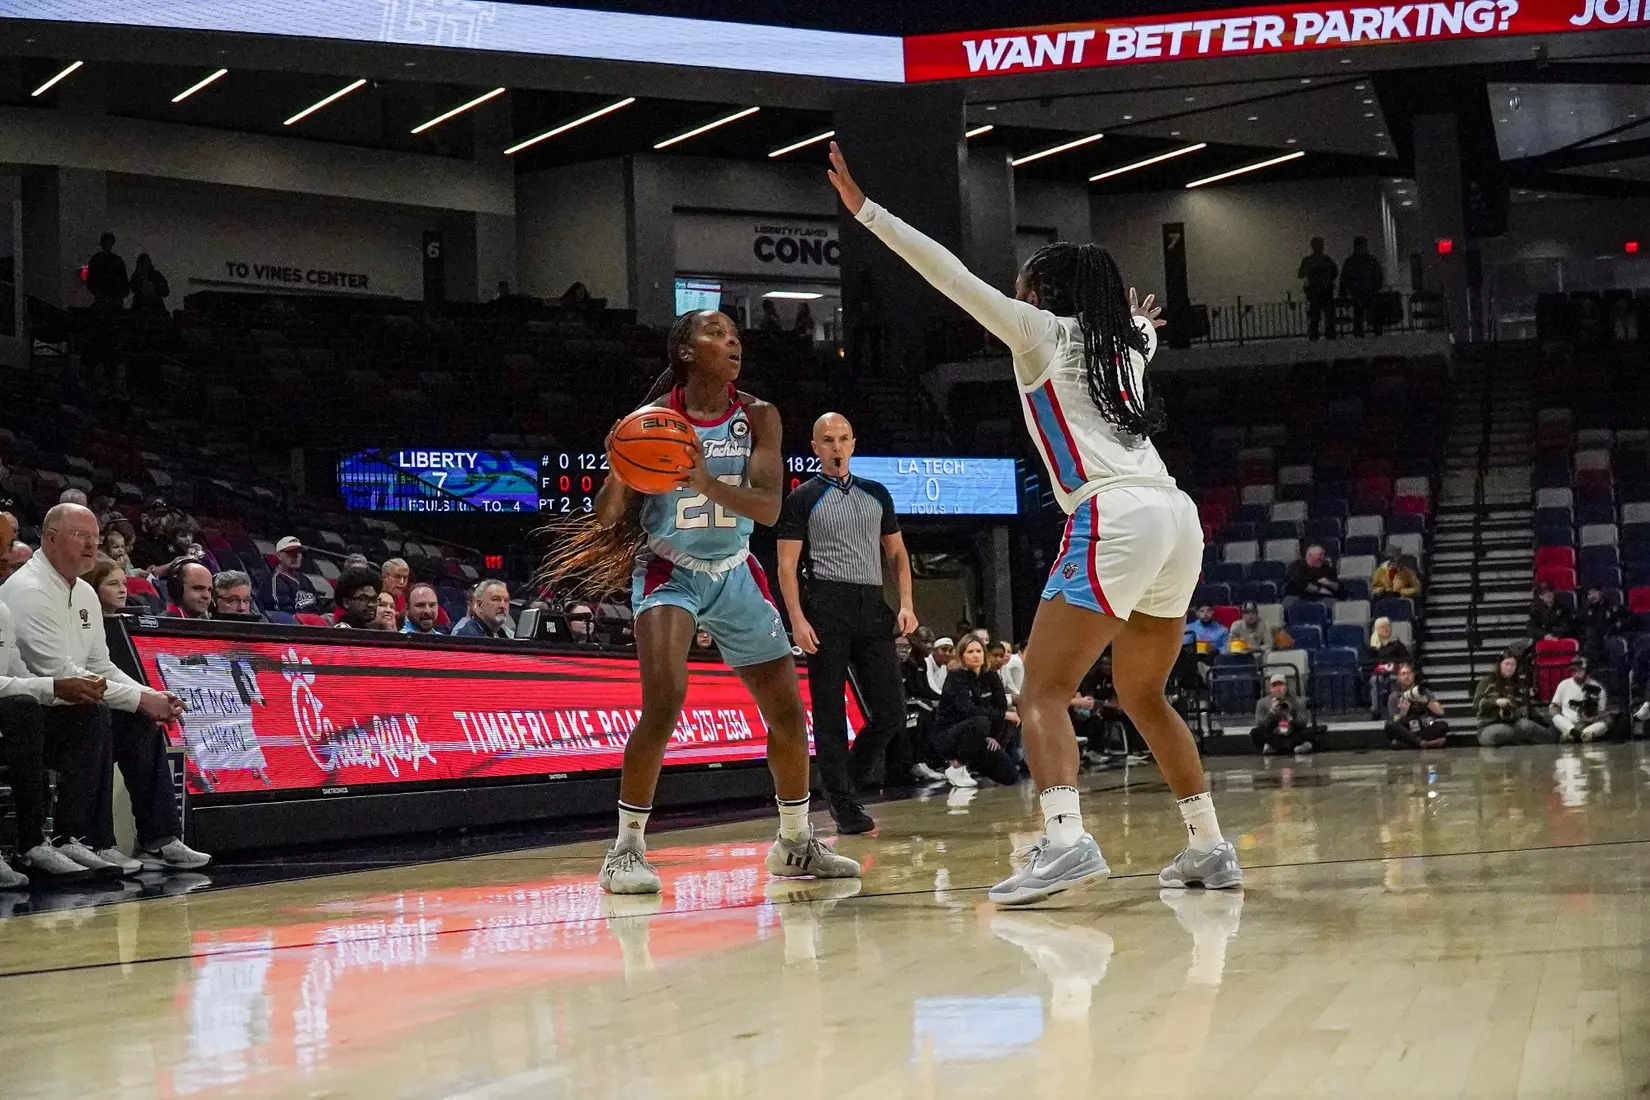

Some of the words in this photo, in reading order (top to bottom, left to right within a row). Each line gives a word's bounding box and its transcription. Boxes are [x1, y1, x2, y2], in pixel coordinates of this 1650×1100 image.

[962, 29, 1095, 73] WANT
[1105, 14, 1285, 61] BETTER
[1293, 0, 1519, 46] PARKING?
[426, 241, 440, 258] 6
[225, 261, 249, 279] TO
[252, 263, 302, 283] VINES
[305, 269, 369, 289] CENTER
[641, 417, 688, 433] ELITE
[399, 451, 478, 469] LIBERTY
[559, 453, 569, 469] 0
[577, 453, 596, 469] 12
[786, 457, 804, 473] 18
[897, 459, 920, 474] LA
[922, 459, 965, 475] TECH
[432, 472, 448, 497] 7
[542, 477, 550, 488] F
[559, 475, 570, 492] 0
[581, 475, 592, 492] 0
[926, 477, 940, 501] 0
[482, 500, 504, 512] T.O.
[513, 500, 521, 512] 4
[538, 498, 555, 510] PT
[560, 496, 571, 513] 2
[582, 496, 593, 513] 3
[911, 503, 945, 514] FOULS
[453, 710, 600, 754] TIMBERLAKE
